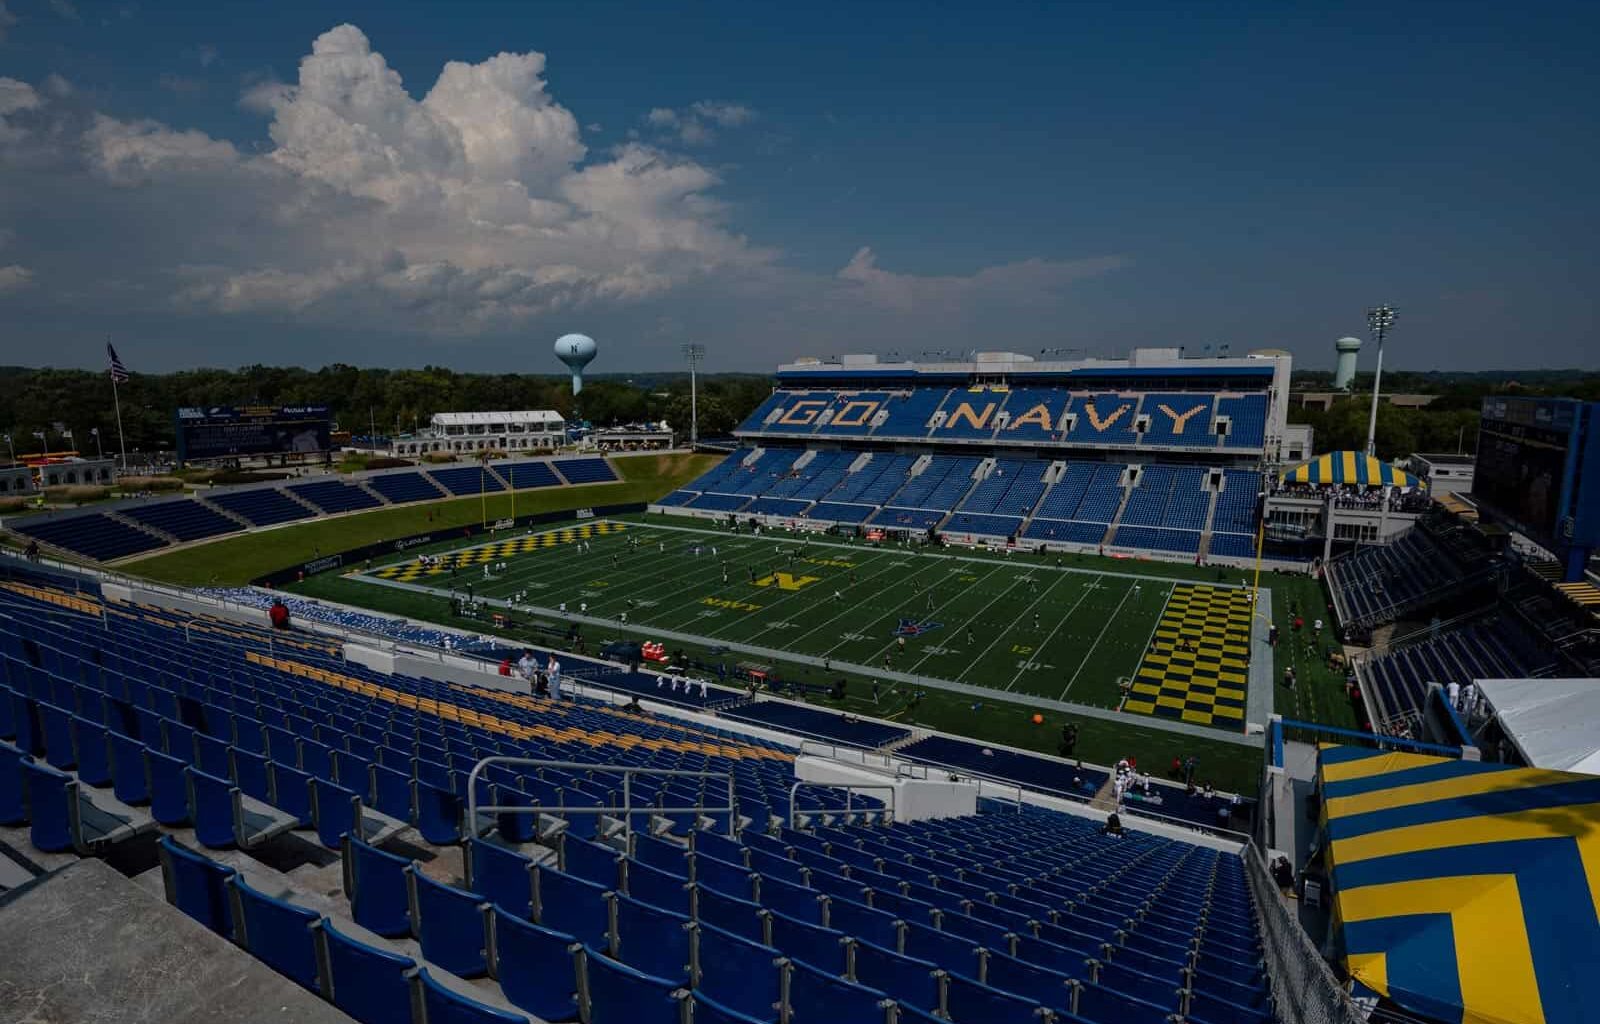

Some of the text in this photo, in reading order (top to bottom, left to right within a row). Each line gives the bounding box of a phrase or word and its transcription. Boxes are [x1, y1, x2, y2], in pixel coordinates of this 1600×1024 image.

[778, 401, 1207, 434] GO NAVY
[748, 572, 822, 591] N
[702, 597, 764, 611] NAVY
[1010, 645, 1033, 655] 12
